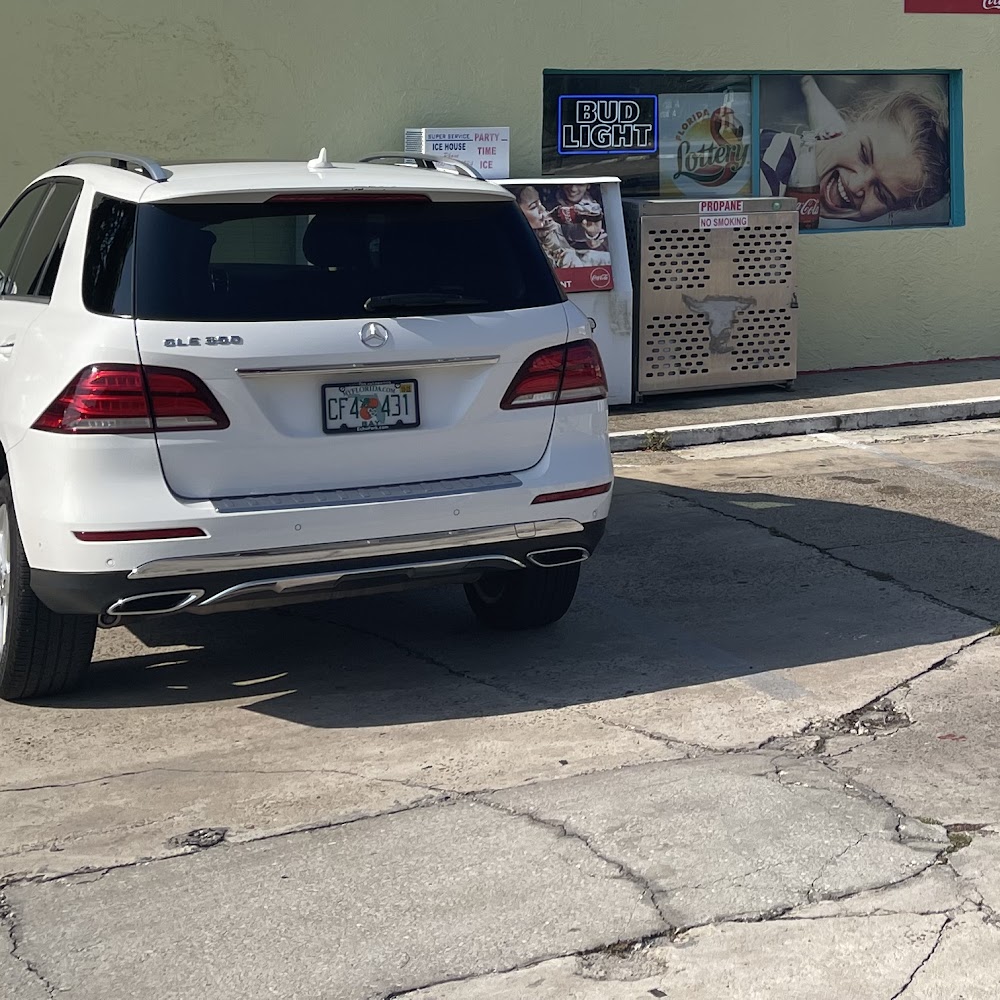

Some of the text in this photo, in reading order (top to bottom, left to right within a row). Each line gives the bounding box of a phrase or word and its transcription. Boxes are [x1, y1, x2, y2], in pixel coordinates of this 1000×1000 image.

[576, 100, 640, 124] BUD
[675, 109, 710, 142] FLORIDA
[474, 132, 500, 142] PARTY
[562, 124, 652, 148] LIGHT
[432, 142, 497, 156] ICE HOUSE TIME
[480, 160, 493, 169] ICE
[673, 140, 750, 179] Lottery
[700, 200, 742, 212] PROPANE
[700, 217, 747, 227] NO SMOKING
